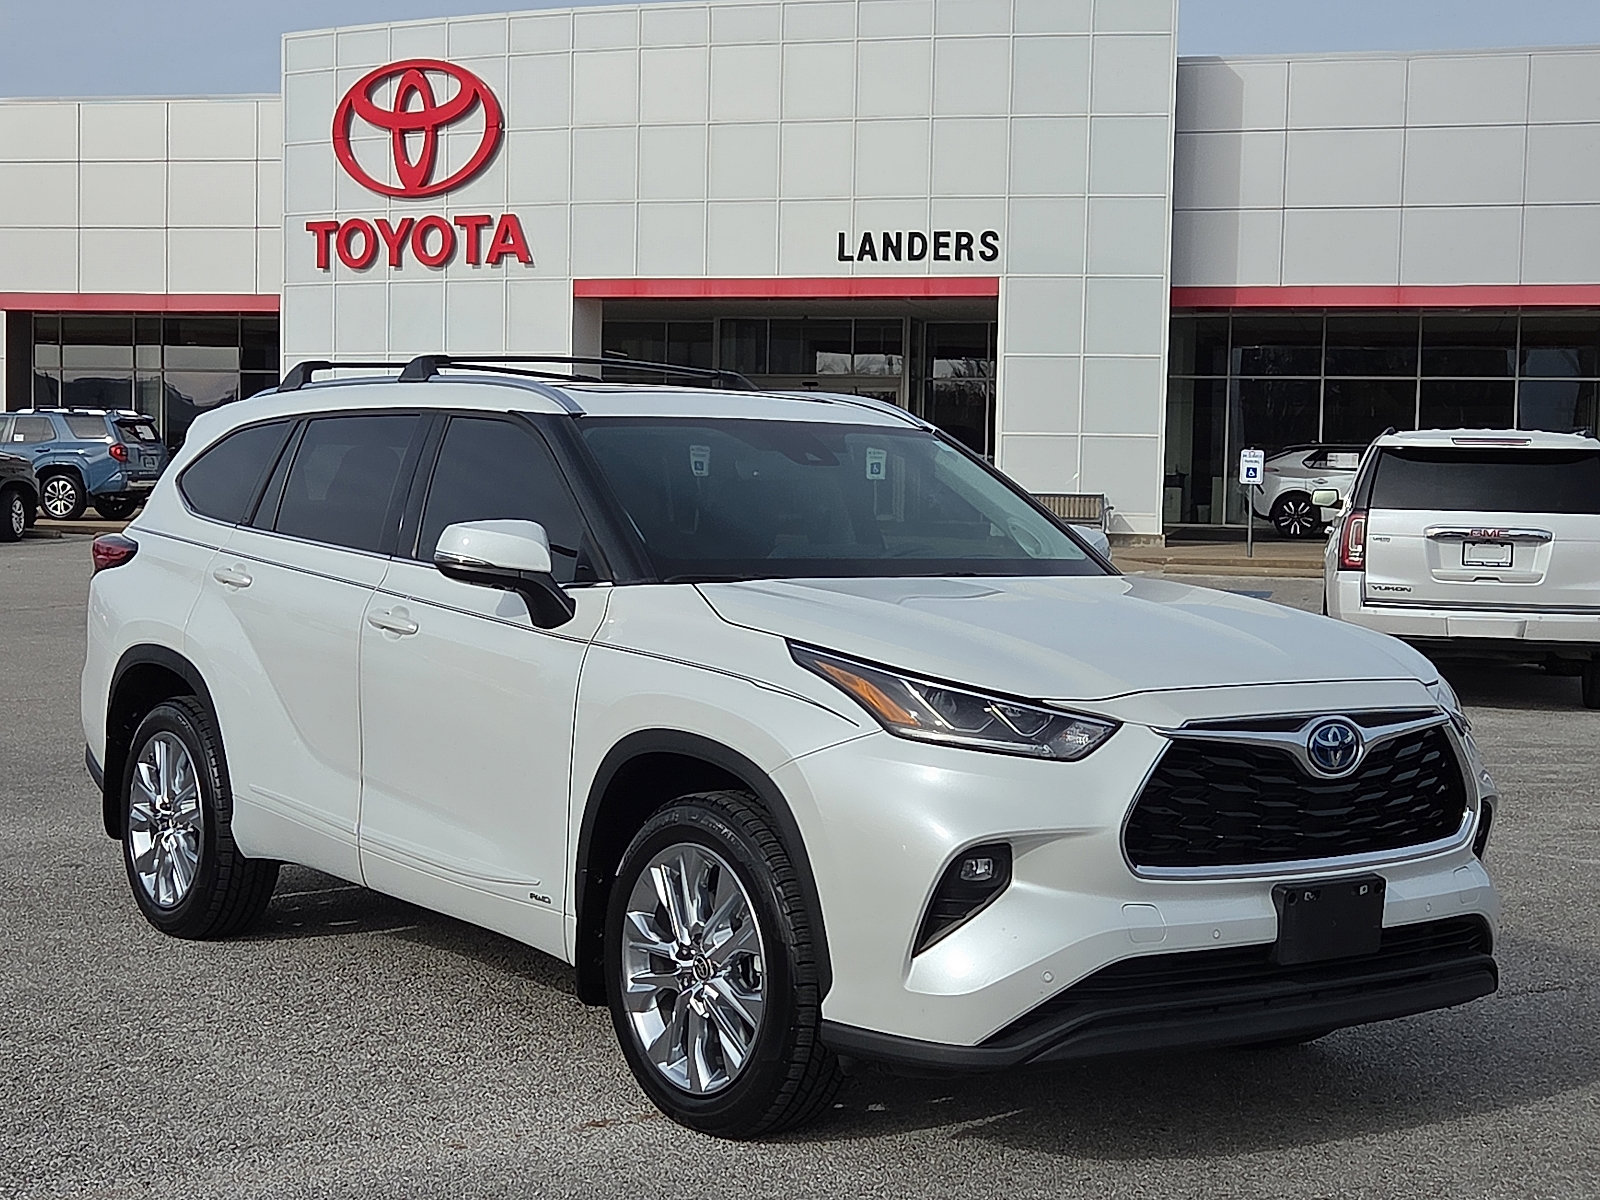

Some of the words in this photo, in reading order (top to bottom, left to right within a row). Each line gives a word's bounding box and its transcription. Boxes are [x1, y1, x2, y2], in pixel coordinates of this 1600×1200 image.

[306, 214, 533, 269] TOYOTA
[837, 230, 1000, 262] LANDERS
[1470, 528, 1509, 538] GMC
